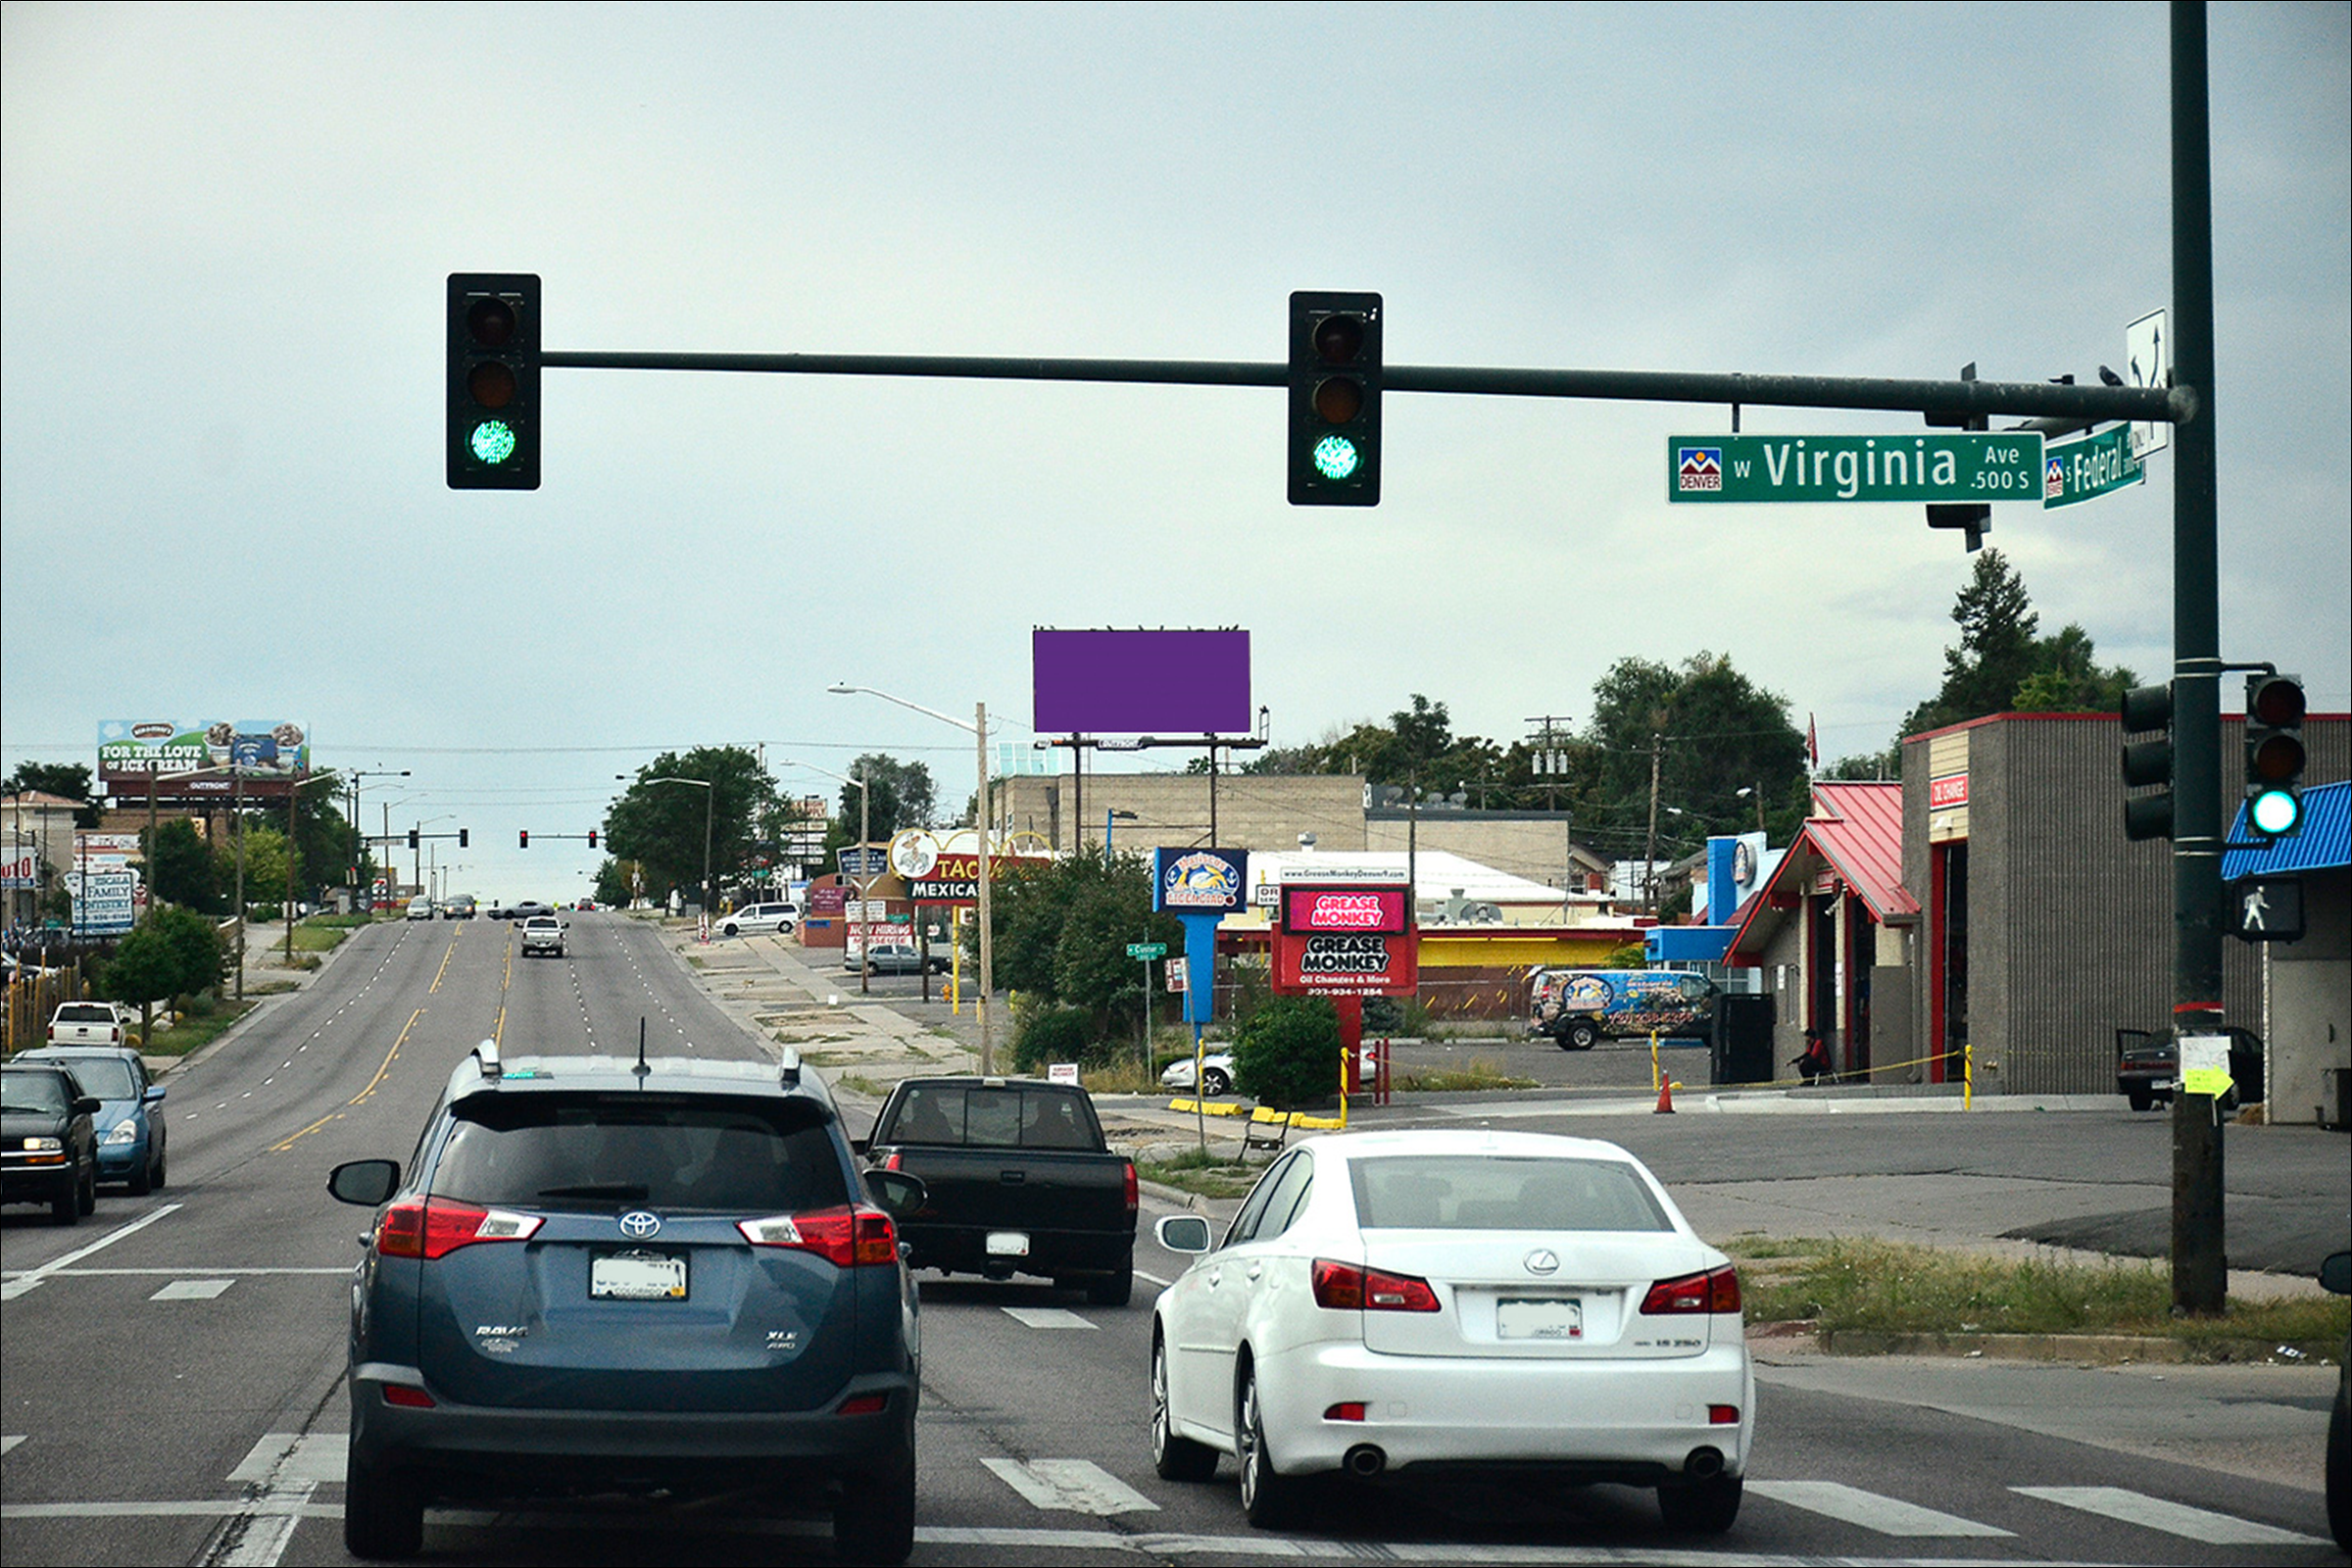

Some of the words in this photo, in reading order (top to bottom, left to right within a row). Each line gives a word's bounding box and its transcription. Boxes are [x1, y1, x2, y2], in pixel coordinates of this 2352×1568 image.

[1984, 446, 2020, 465] Ave
[1734, 461, 1751, 478] W
[1763, 439, 1957, 498] Virginia
[2075, 436, 2122, 492] Federal
[1680, 475, 1721, 489] DENVER
[2019, 471, 2030, 489] S
[102, 746, 130, 758] FOR
[133, 746, 163, 758] THE
[164, 746, 202, 758] LOVE
[121, 760, 146, 771] ICE
[147, 760, 199, 771] CREAM
[0, 857, 31, 878] UTO
[937, 858, 991, 879] TAC
[1178, 852, 1229, 872] Mariscos
[87, 886, 130, 898] FAMILY
[911, 882, 981, 897] MEXICA
[74, 900, 130, 909] DNTISTRY
[1317, 897, 1378, 910] GREASE
[1312, 911, 1382, 924] MONKEY
[875, 924, 910, 935] HIRING
[1309, 937, 1384, 954] GREASE
[1302, 955, 1389, 970] MONKEY
[1299, 975, 1313, 984] Oil
[1314, 975, 1355, 984] Changes
[1366, 975, 1391, 984] More
[475, 1326, 527, 1336] RAV4
[765, 1332, 798, 1341] XLE
